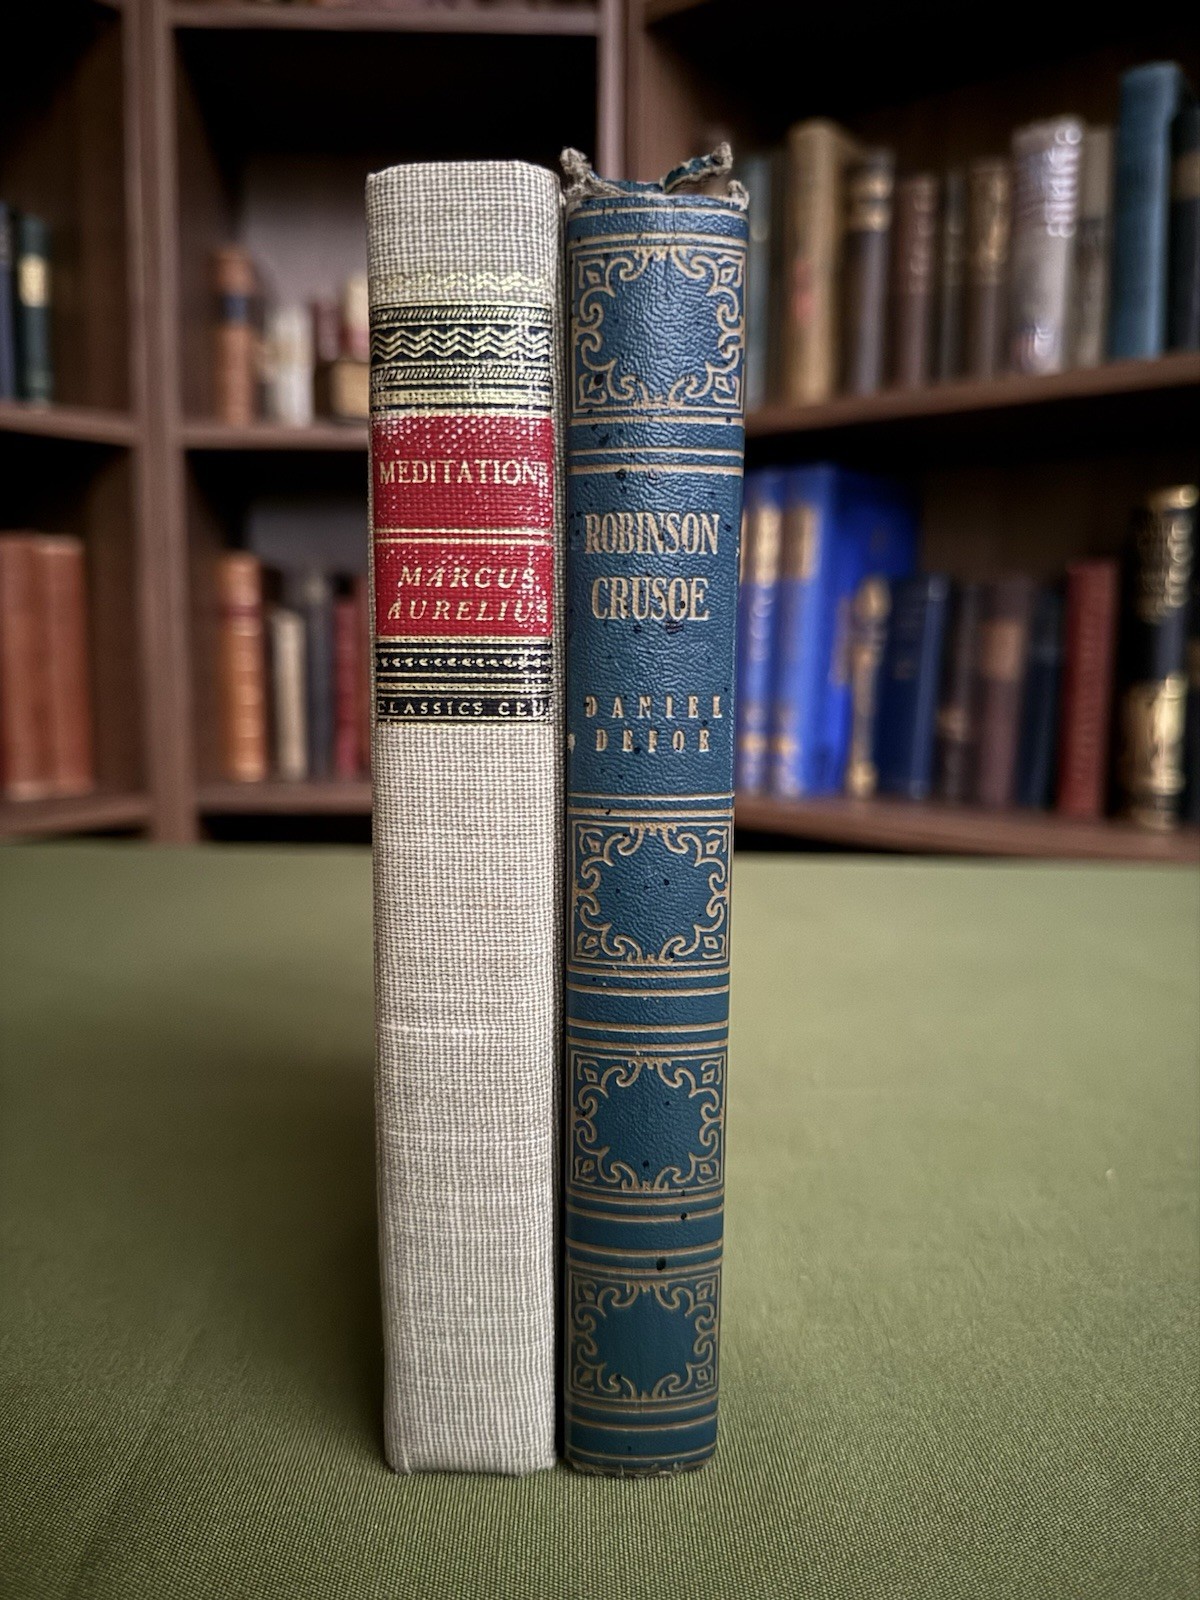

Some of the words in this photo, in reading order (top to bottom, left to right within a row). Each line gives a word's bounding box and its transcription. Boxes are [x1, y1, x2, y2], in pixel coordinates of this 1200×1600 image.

[584, 511, 720, 556] ROBINSON
[398, 566, 536, 589] MARCUS
[591, 576, 711, 622] CRUSOE
[377, 701, 484, 716] CLASSICS
[584, 695, 723, 719] DANIEL
[595, 729, 710, 753] DEFOE
